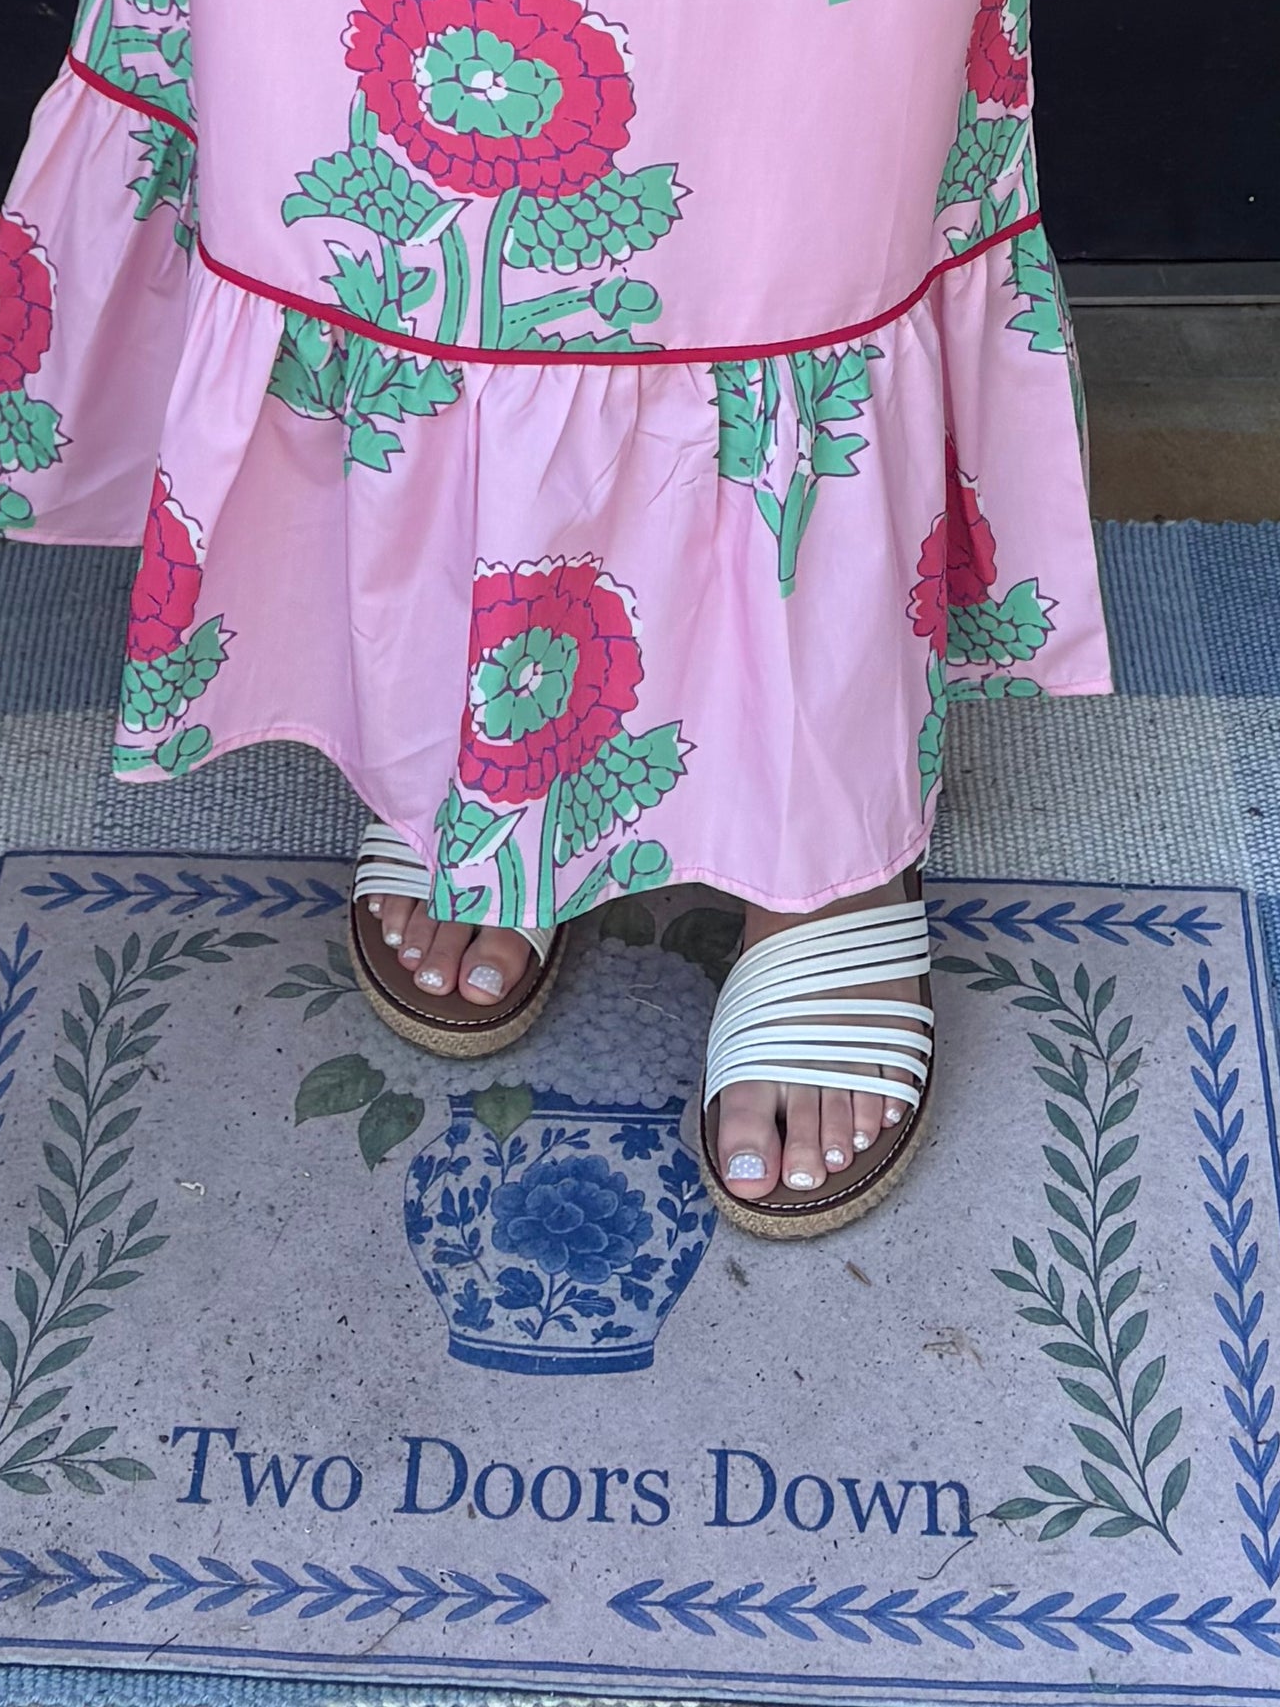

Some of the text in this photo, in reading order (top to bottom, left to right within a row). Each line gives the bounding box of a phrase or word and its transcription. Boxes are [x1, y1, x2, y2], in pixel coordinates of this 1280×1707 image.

[171, 1425, 978, 1539] Two Doors Down
